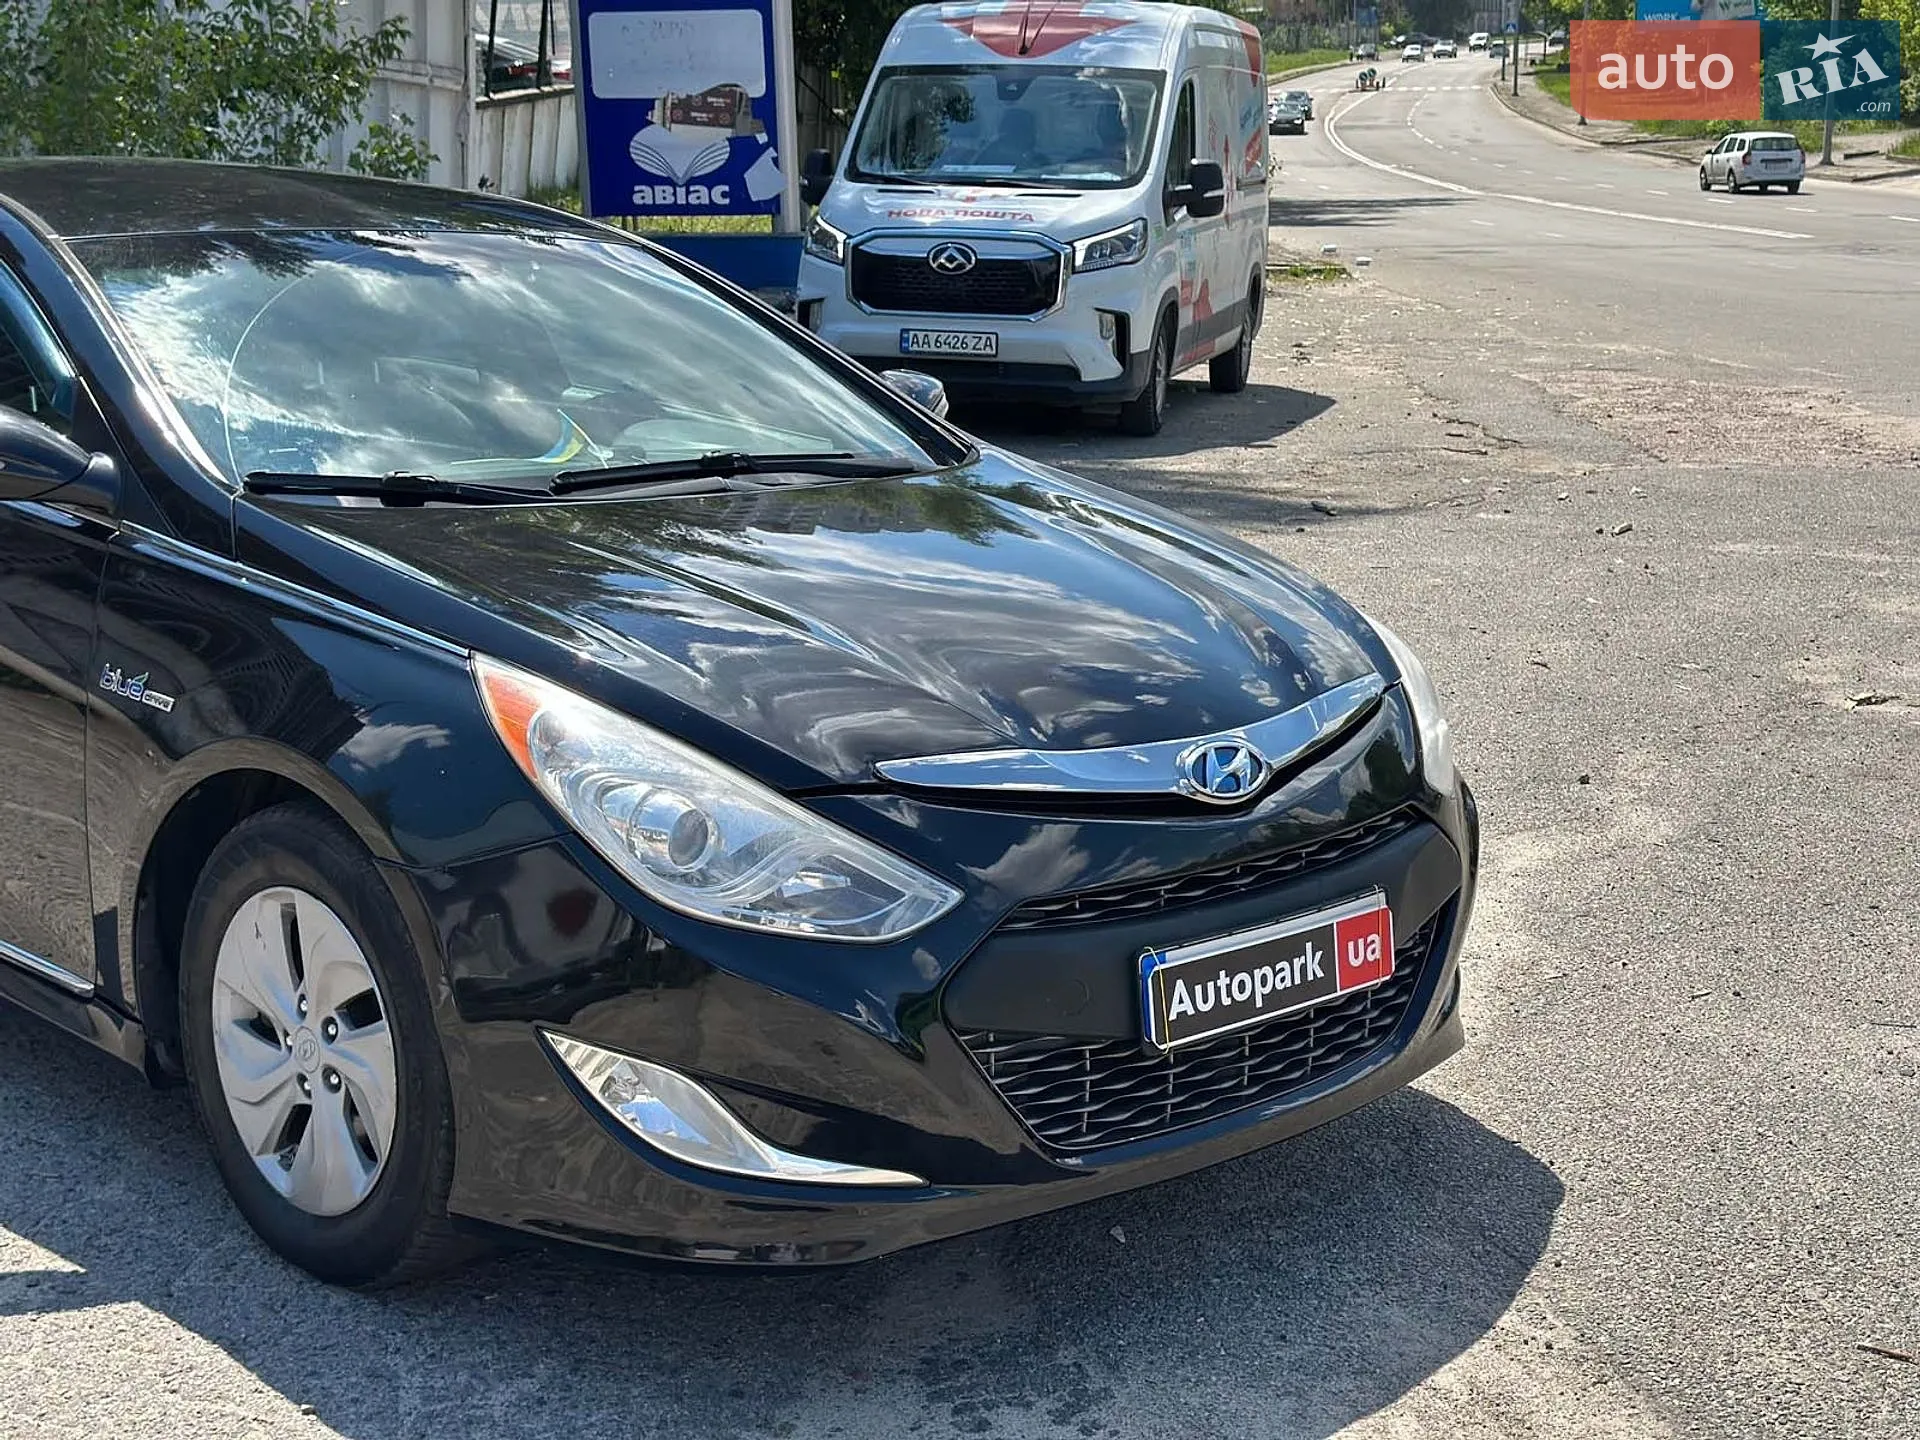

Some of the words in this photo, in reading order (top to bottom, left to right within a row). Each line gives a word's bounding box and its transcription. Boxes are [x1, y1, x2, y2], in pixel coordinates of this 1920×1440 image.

[954, 209, 1035, 222] ПОШТА
[910, 333, 931, 349] AA
[935, 334, 969, 350] 6426
[972, 335, 994, 352] ZA
[99, 662, 145, 701] blue
[1168, 942, 1325, 1021] Autopark
[1347, 932, 1382, 967] ua
